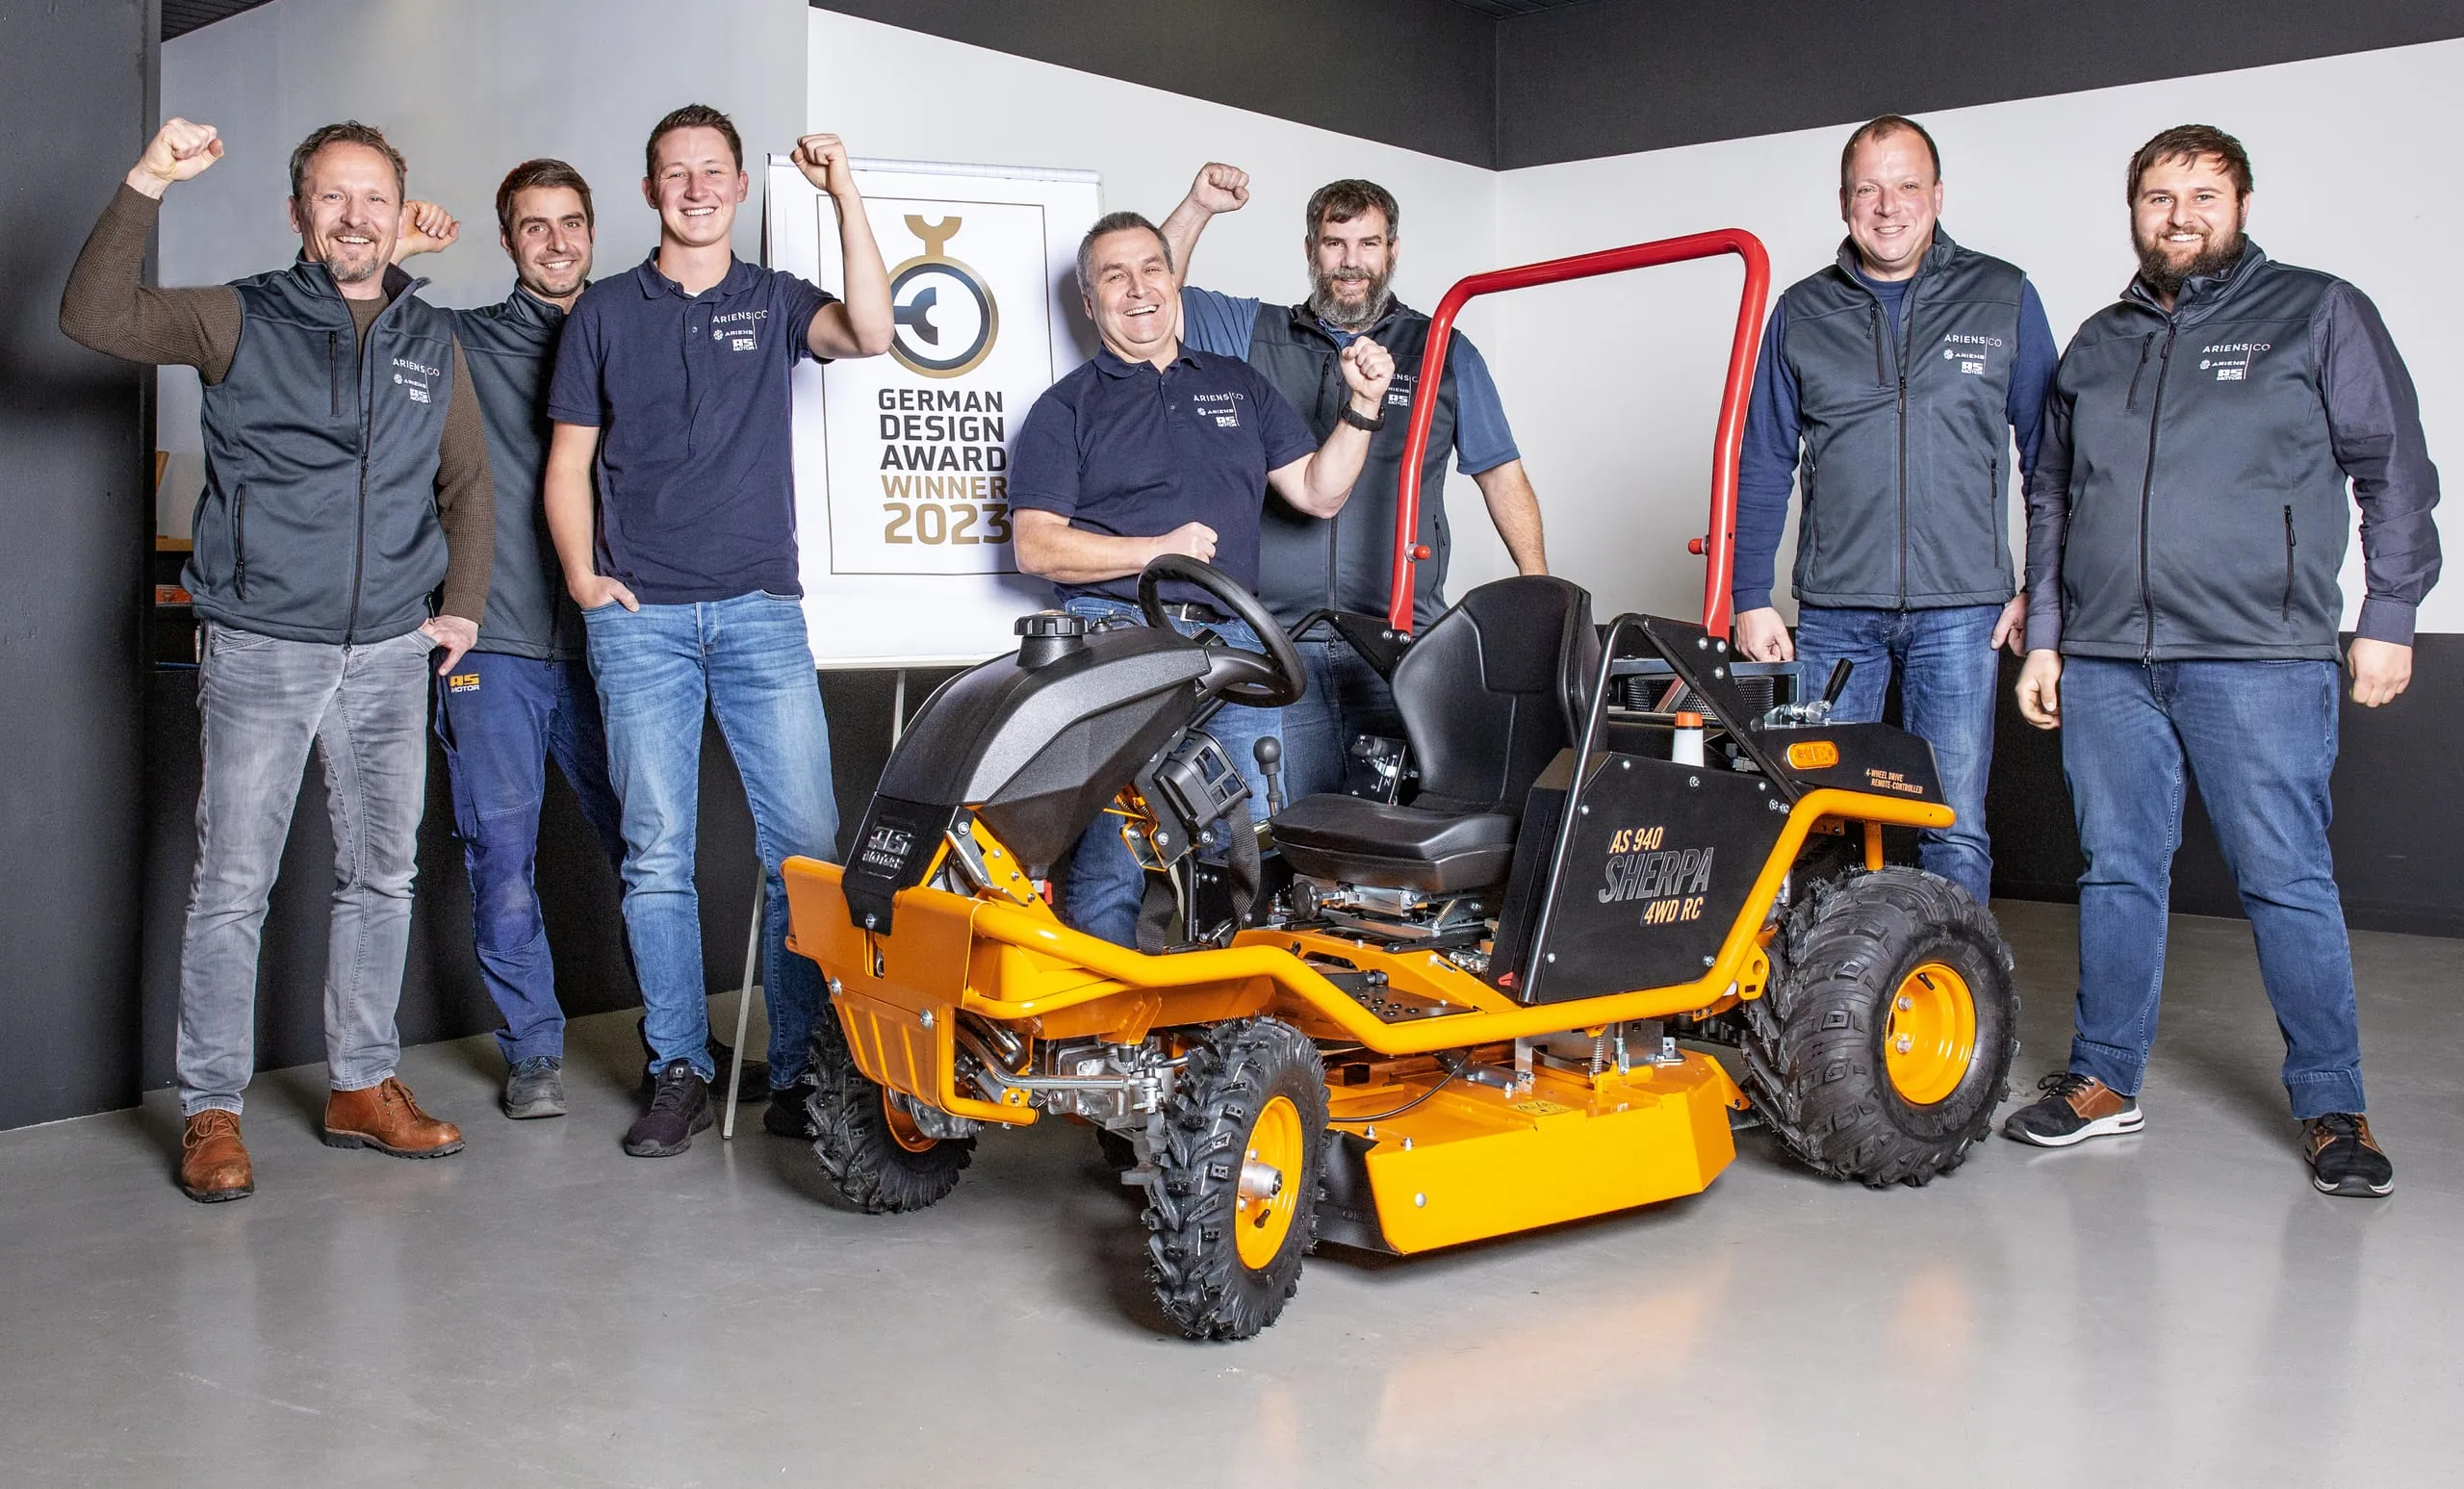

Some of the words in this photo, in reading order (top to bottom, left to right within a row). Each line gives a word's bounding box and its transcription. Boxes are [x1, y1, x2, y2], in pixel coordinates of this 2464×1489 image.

[712, 312, 752, 323] ARIENS
[1944, 334, 1986, 345] ARIENS
[2202, 343, 2249, 353] ARIENS
[393, 357, 425, 373] ARIENS
[878, 388, 1003, 413] GERMAN
[880, 414, 1005, 442] DESIGN
[880, 445, 1007, 472] AWARD
[881, 475, 1008, 500] WINNER
[883, 502, 1012, 545] 2023
[450, 684, 480, 693] MOTOR
[1608, 829, 1633, 855] AS
[1632, 826, 1664, 852] 940
[1598, 847, 1714, 904] SHERPA
[1643, 899, 1680, 925] 4WD
[1680, 896, 1704, 921] RC
